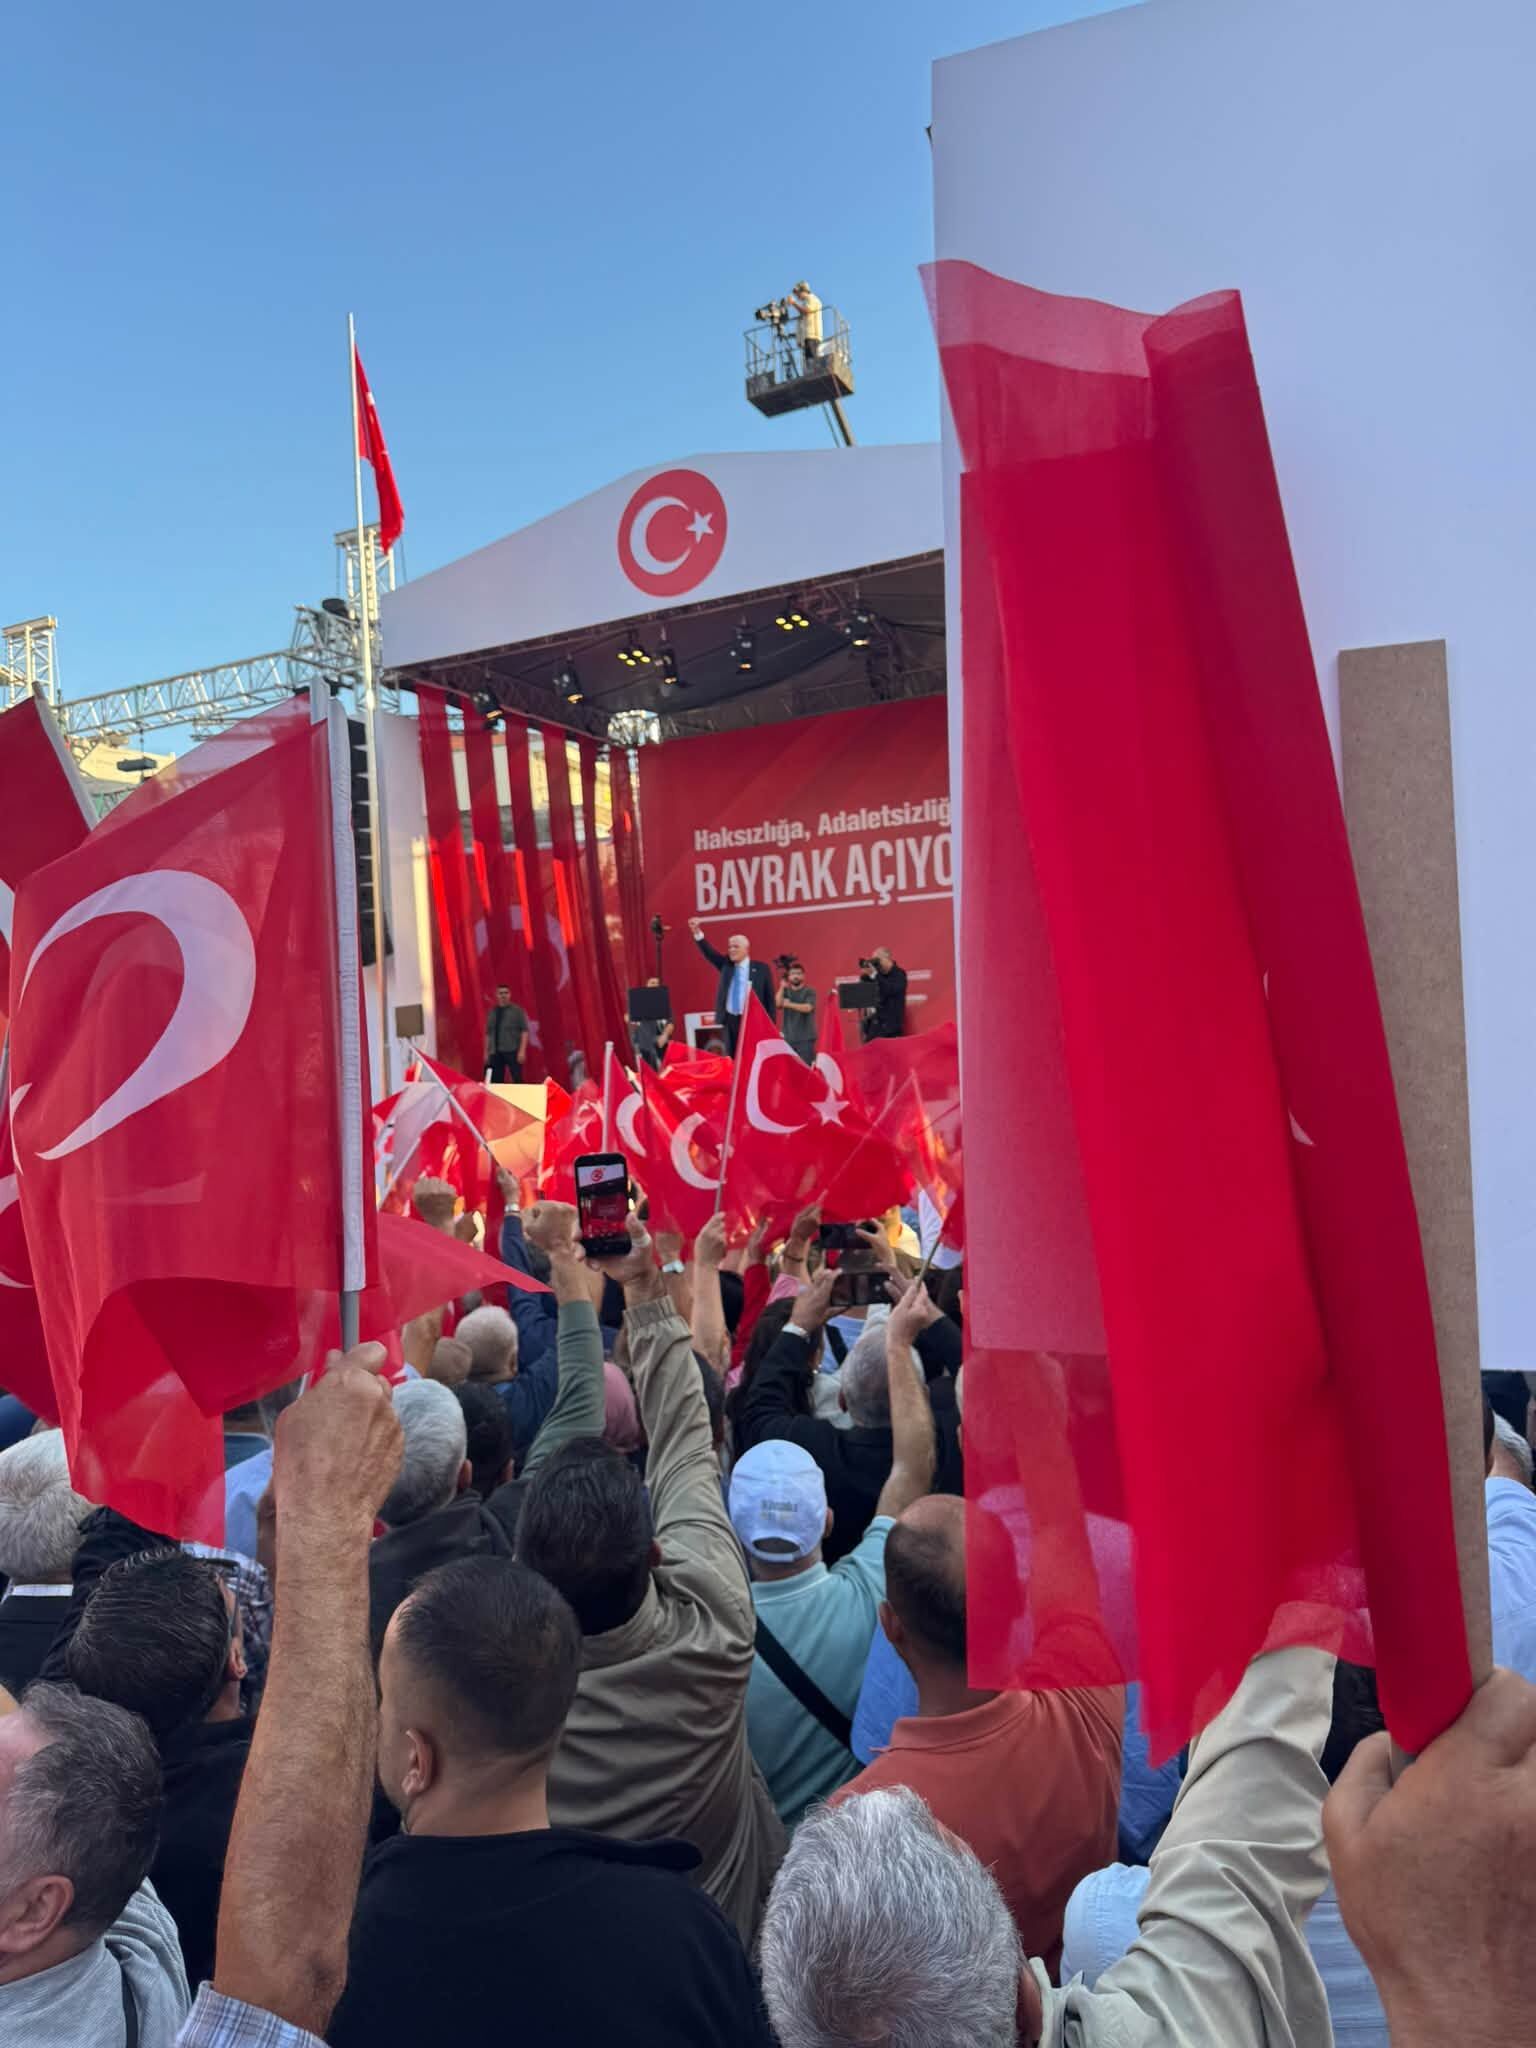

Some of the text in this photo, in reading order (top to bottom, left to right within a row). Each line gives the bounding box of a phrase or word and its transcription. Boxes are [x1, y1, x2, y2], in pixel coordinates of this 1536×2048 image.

[694, 819, 811, 851] Haksızlığa,
[695, 833, 952, 912] BAYRAK AÇIYO
